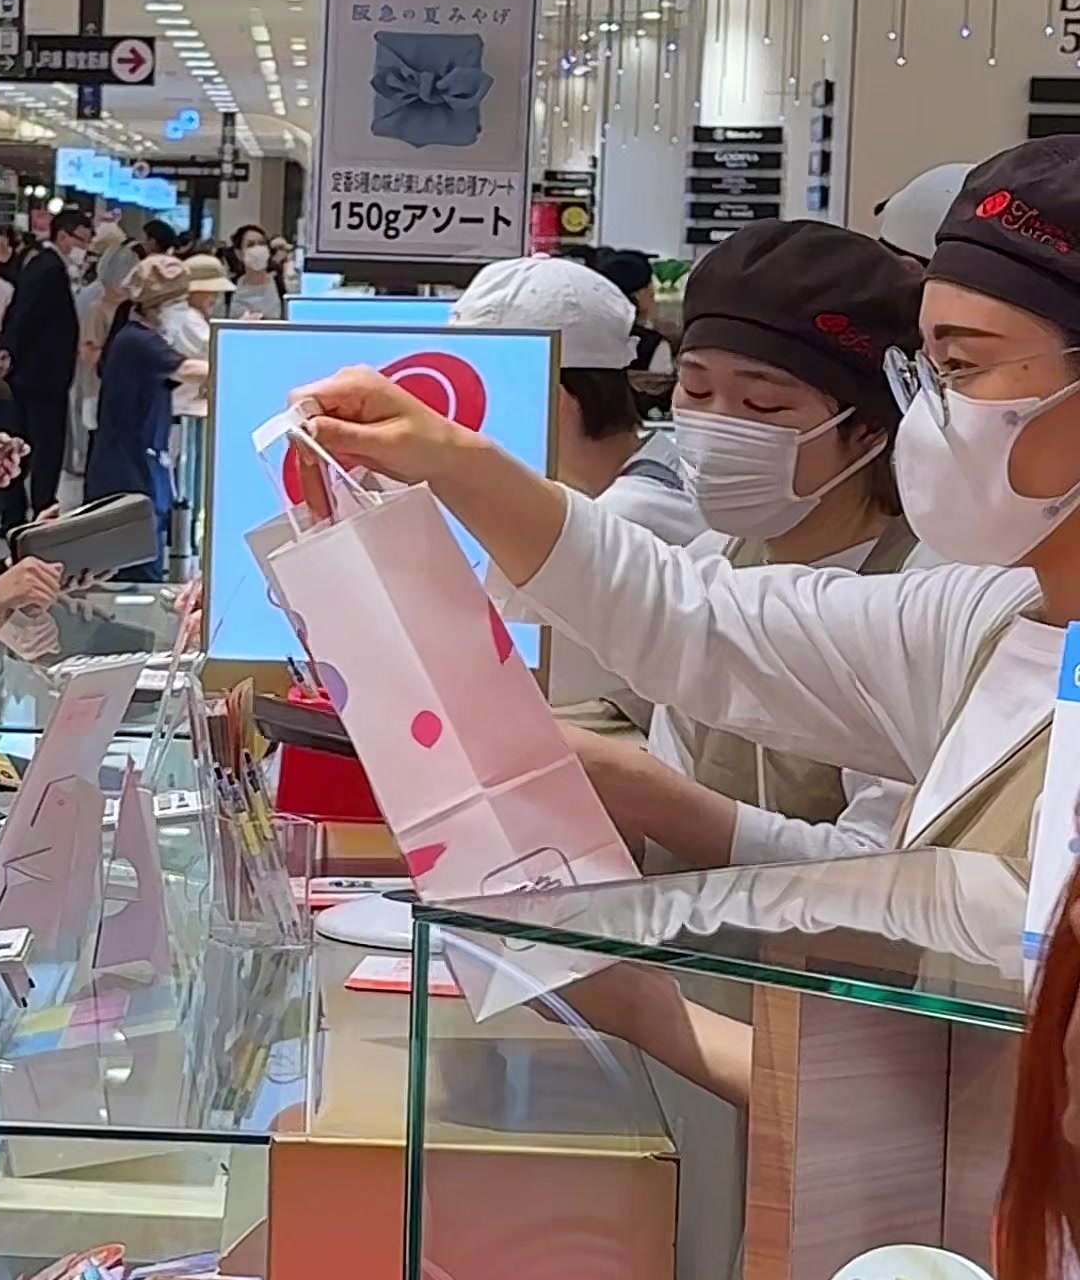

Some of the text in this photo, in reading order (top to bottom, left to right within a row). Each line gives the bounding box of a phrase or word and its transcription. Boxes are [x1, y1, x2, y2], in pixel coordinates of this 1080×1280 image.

[351, 3, 511, 25] 阪急の夏みやげ
[331, 201, 512, 240] 150gアソート
